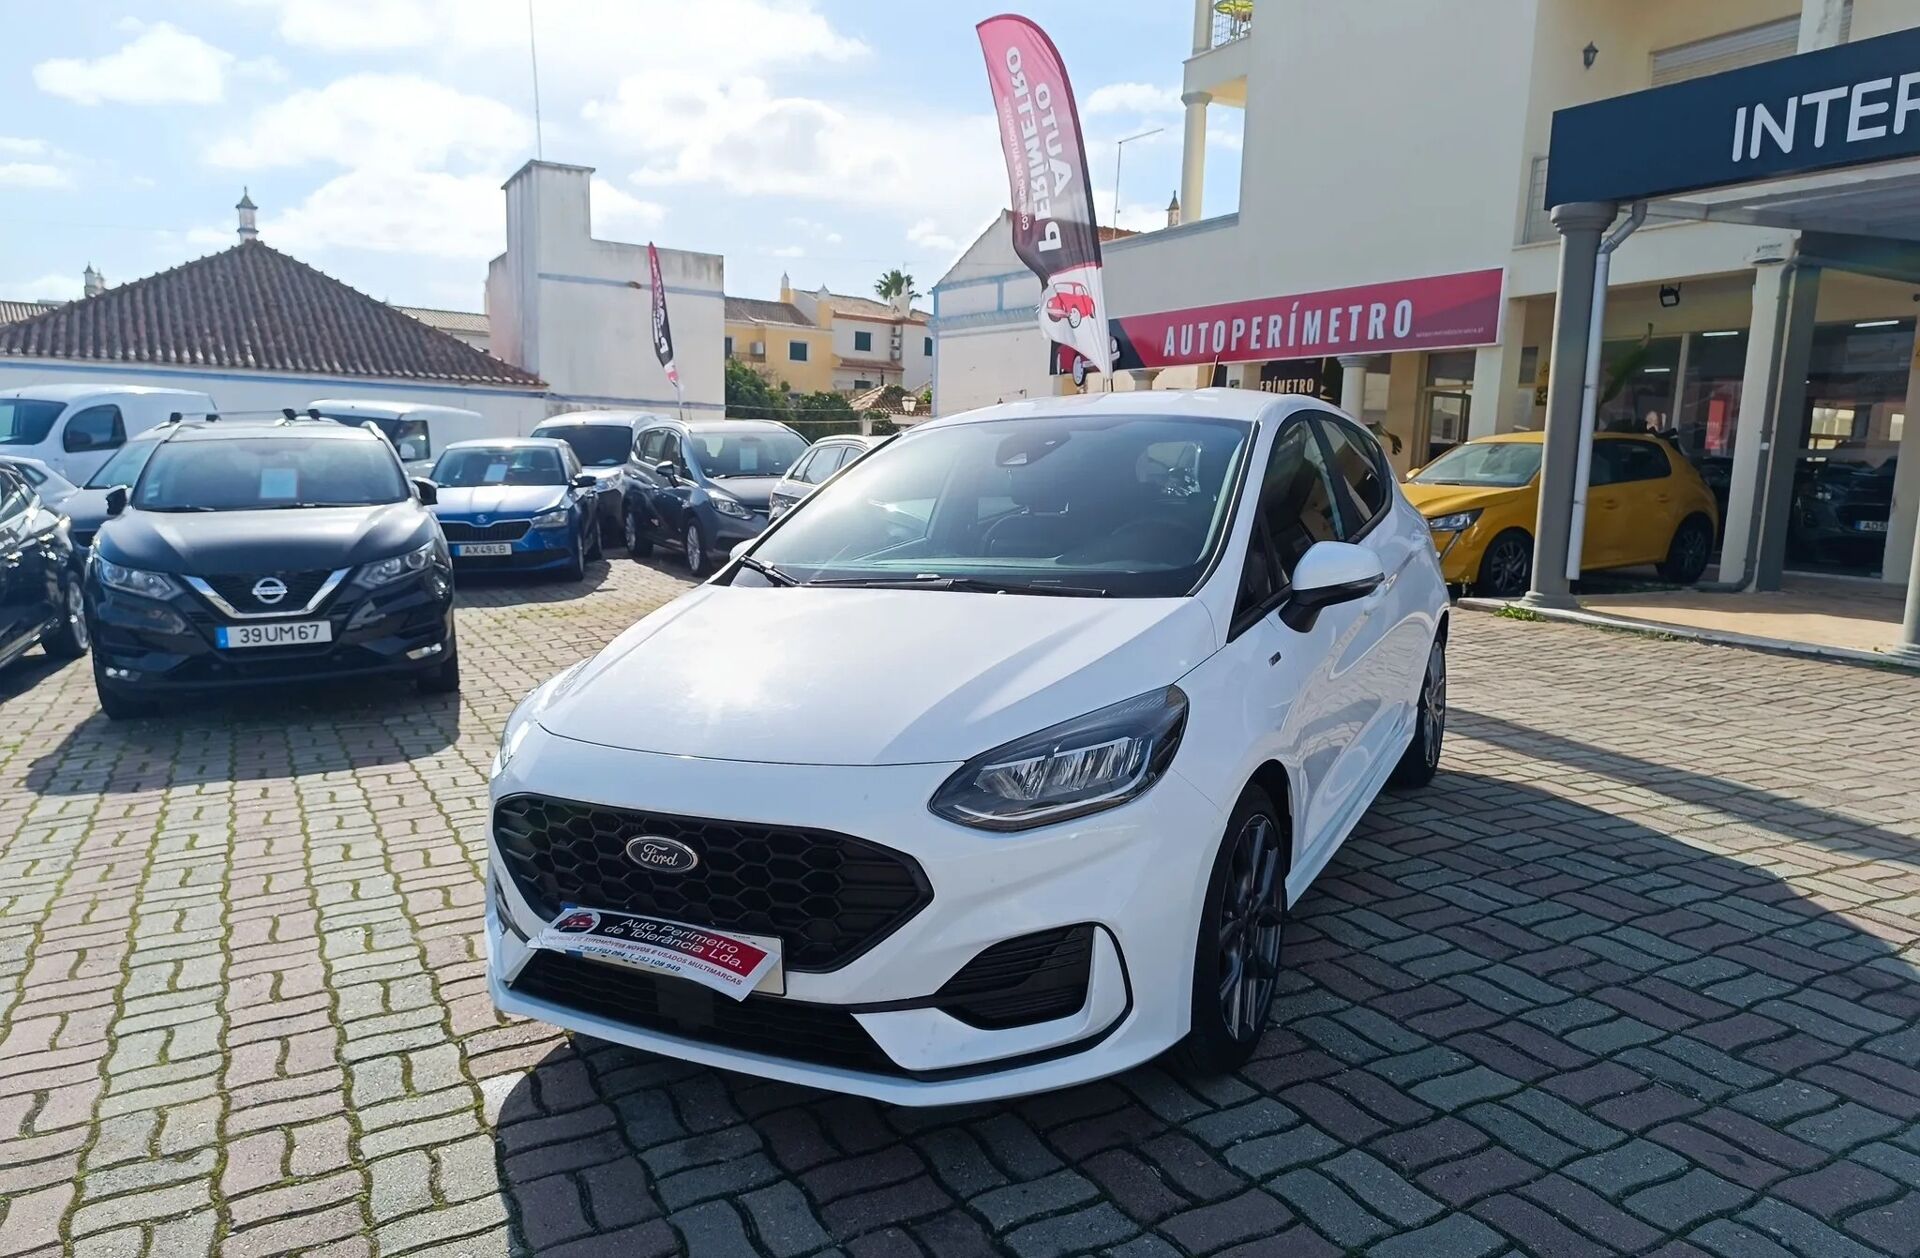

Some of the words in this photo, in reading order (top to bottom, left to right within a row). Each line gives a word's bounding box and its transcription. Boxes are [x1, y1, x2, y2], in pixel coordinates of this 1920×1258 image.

[1163, 299, 1412, 357] AUTOPERÍMETRO
[641, 843, 678, 867] Ford
[604, 925, 624, 934] de
[630, 928, 705, 953] Tolerância
[709, 948, 742, 969] Lda.
[620, 919, 657, 931] Auto
[660, 925, 739, 953] Perímetro
[626, 945, 650, 953] NOVOS
[657, 951, 687, 964] USADOS
[688, 960, 743, 986] MULTIMARCAS
[666, 963, 681, 972] 949
